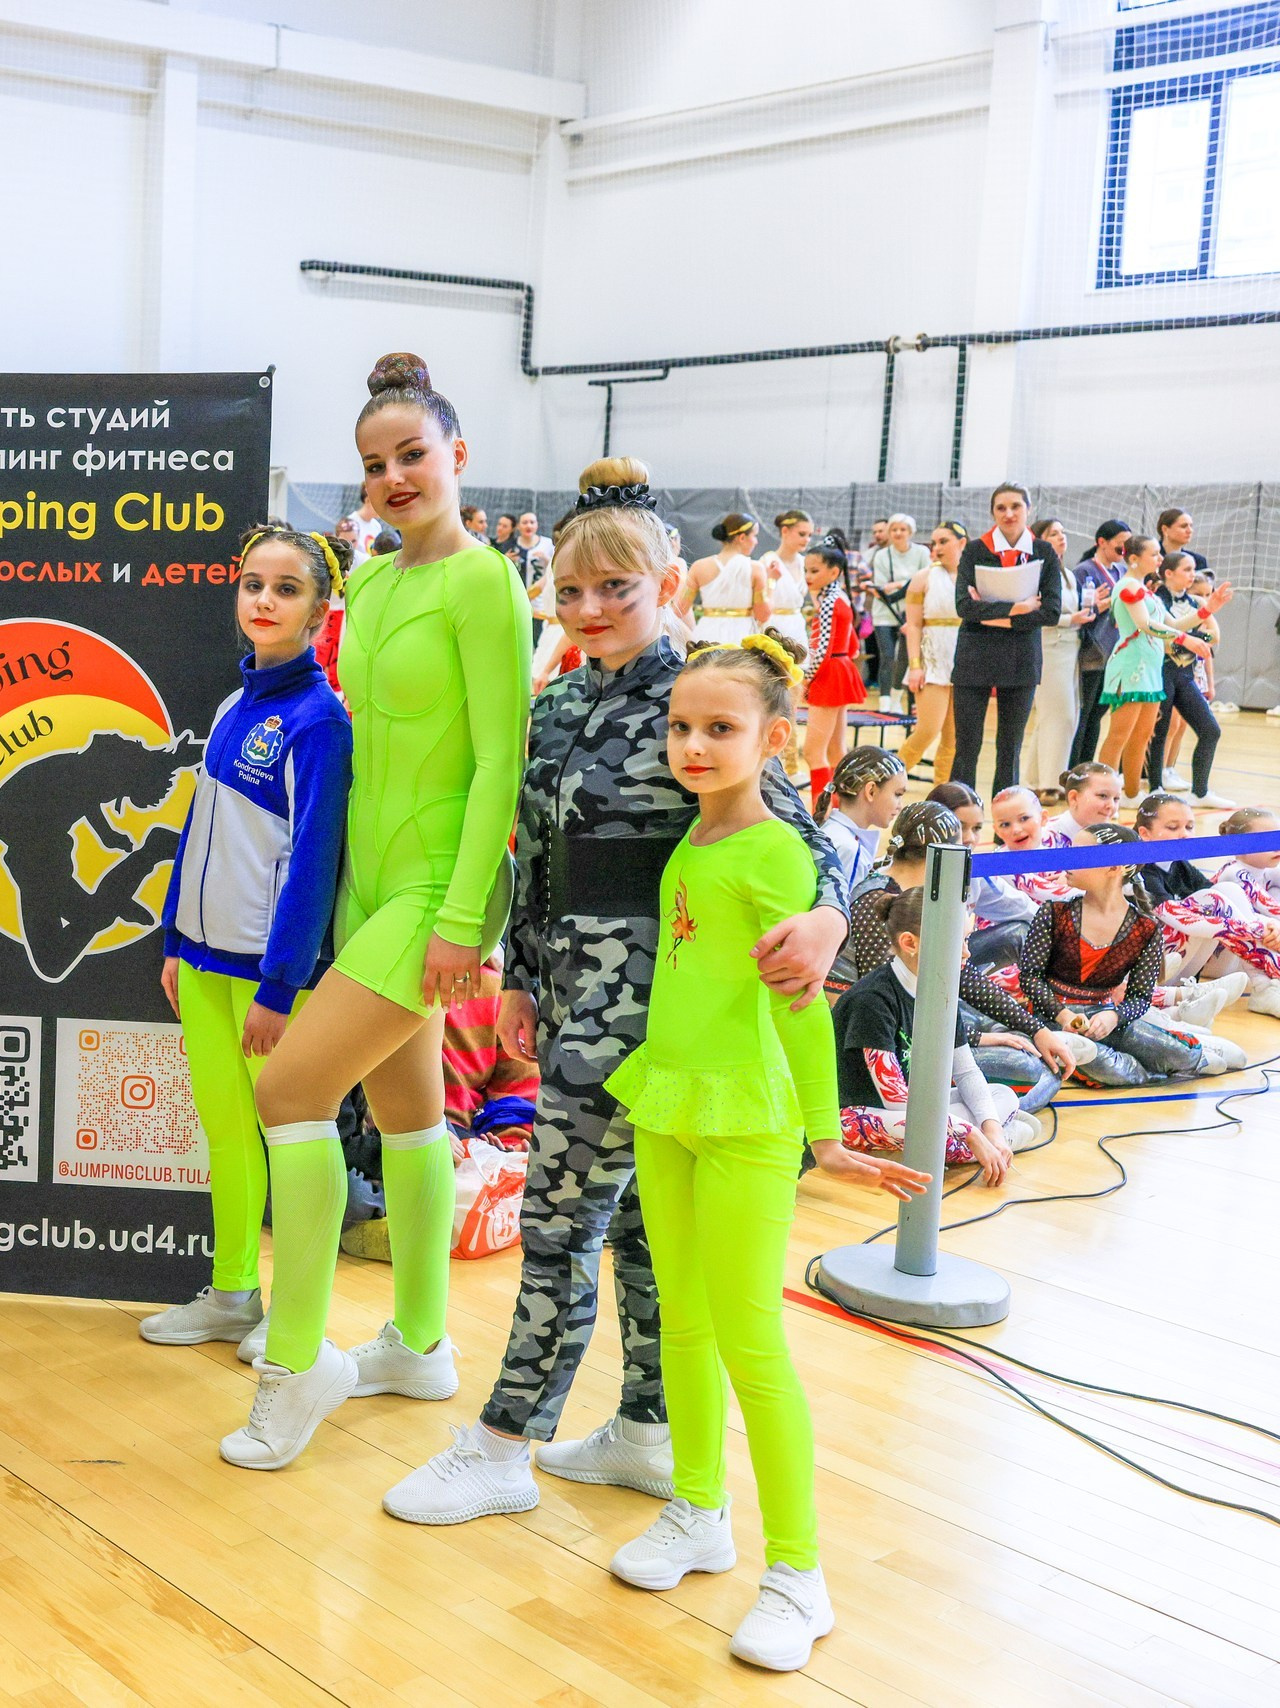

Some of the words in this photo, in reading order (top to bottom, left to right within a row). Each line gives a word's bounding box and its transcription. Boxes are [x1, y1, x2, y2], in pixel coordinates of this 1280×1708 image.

[46, 399, 170, 434] студий
[72, 443, 234, 477] фитнеса
[113, 492, 225, 532] Club
[112, 562, 131, 583] и
[233, 758, 274, 782] Kondratieva
[238, 770, 260, 785] Polina
